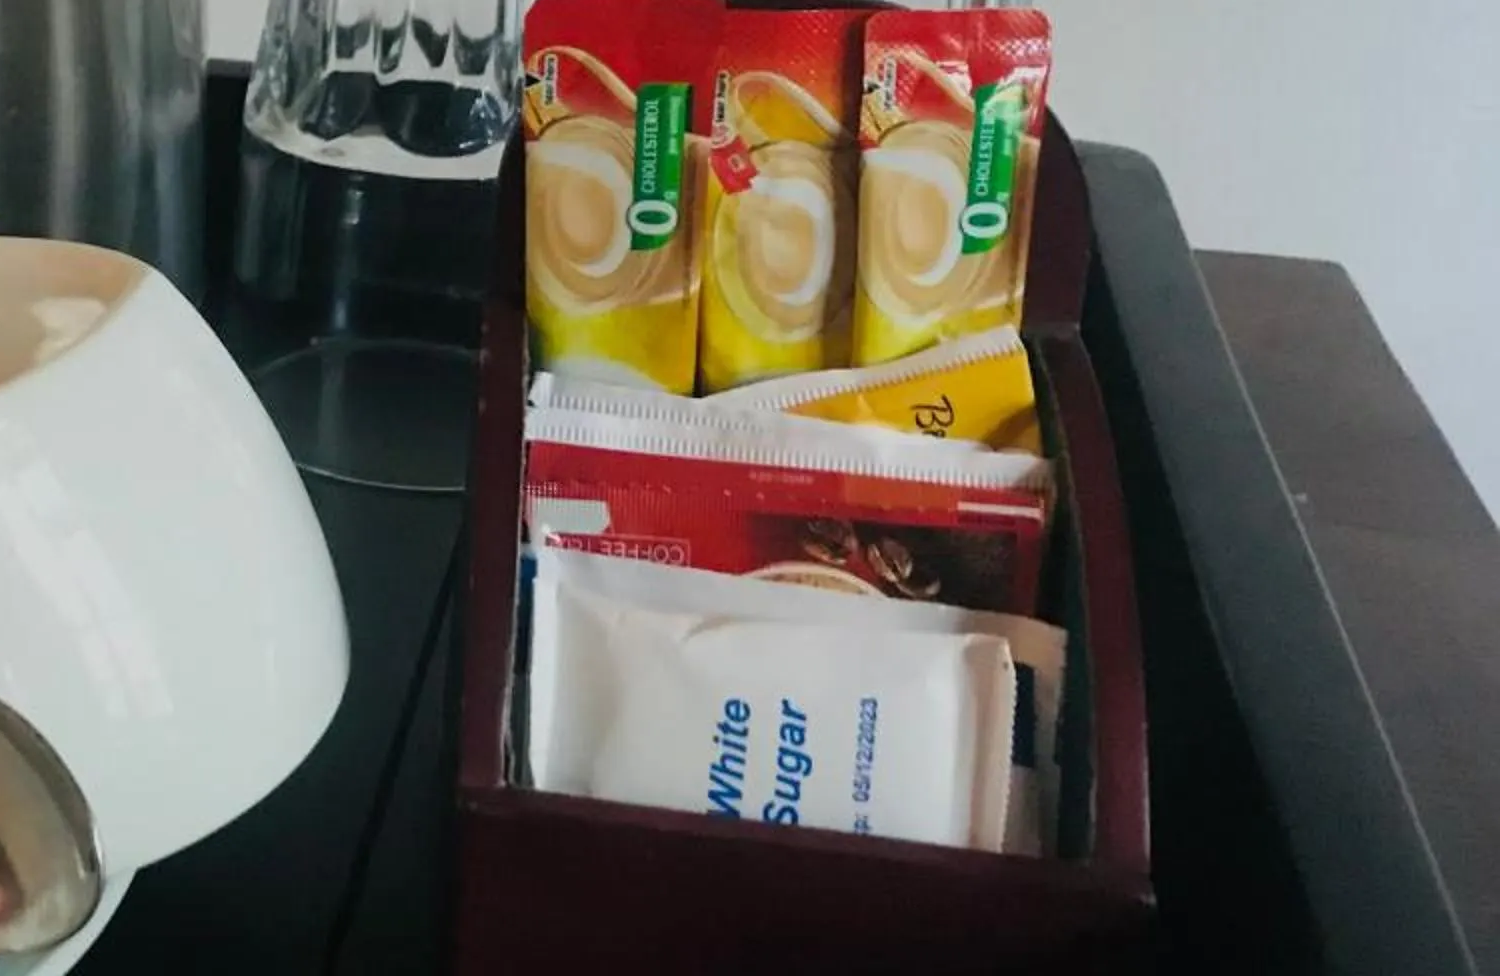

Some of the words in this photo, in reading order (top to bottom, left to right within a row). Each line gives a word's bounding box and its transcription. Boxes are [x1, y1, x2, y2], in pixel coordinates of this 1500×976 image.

[640, 98, 660, 194] CHOLESTEROL
[629, 199, 678, 236] 0
[961, 201, 1008, 239] 0
[601, 540, 685, 565] COFFEE
[706, 697, 751, 820] White
[762, 697, 813, 826] Sugar
[852, 697, 879, 803] 05/12/2023
